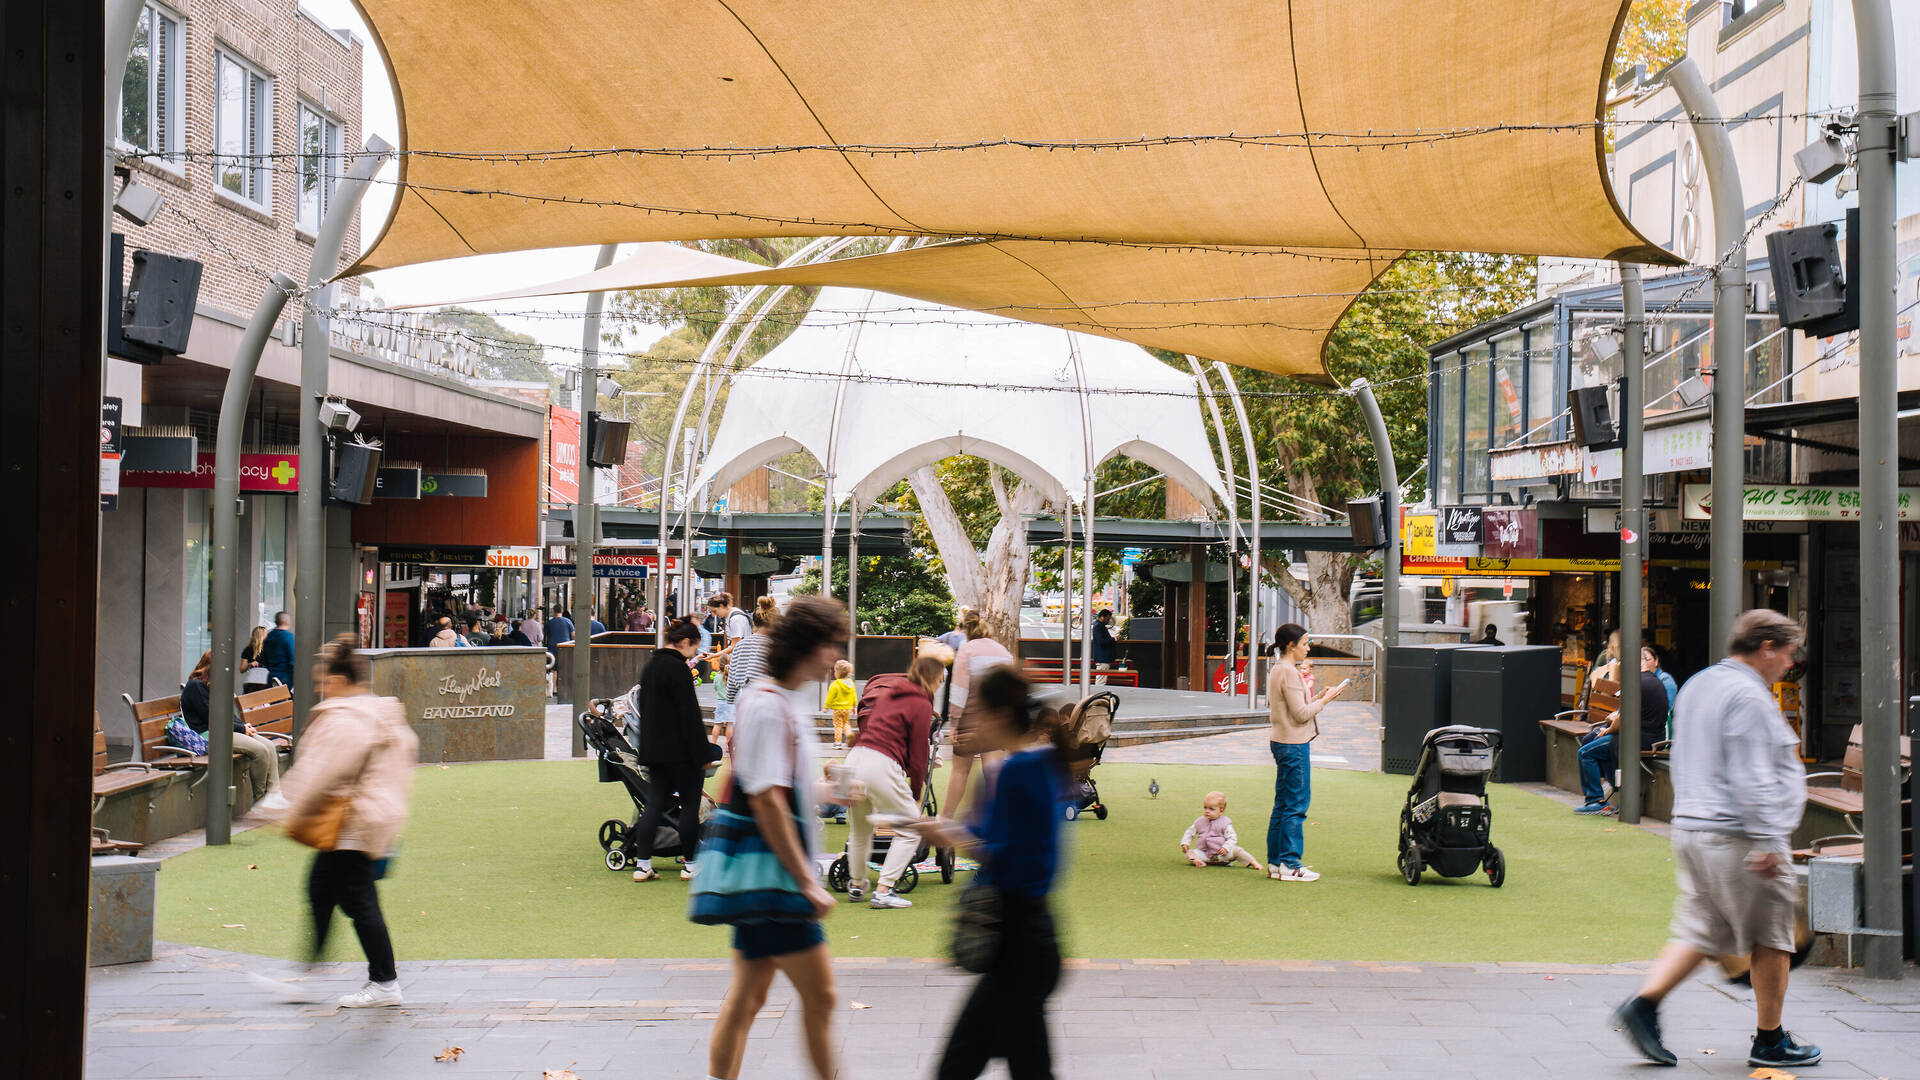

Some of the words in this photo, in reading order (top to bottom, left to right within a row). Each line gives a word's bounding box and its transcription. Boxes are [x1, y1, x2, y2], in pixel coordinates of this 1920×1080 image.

[102, 403, 119, 411] afety
[194, 462, 269, 480] phacy
[1780, 487, 1833, 506] SAM
[1807, 508, 1830, 516] House
[487, 549, 530, 567] simo
[593, 555, 644, 566] DYMOCKS
[608, 567, 641, 577] Advice
[423, 704, 515, 719] BANDSTAND
